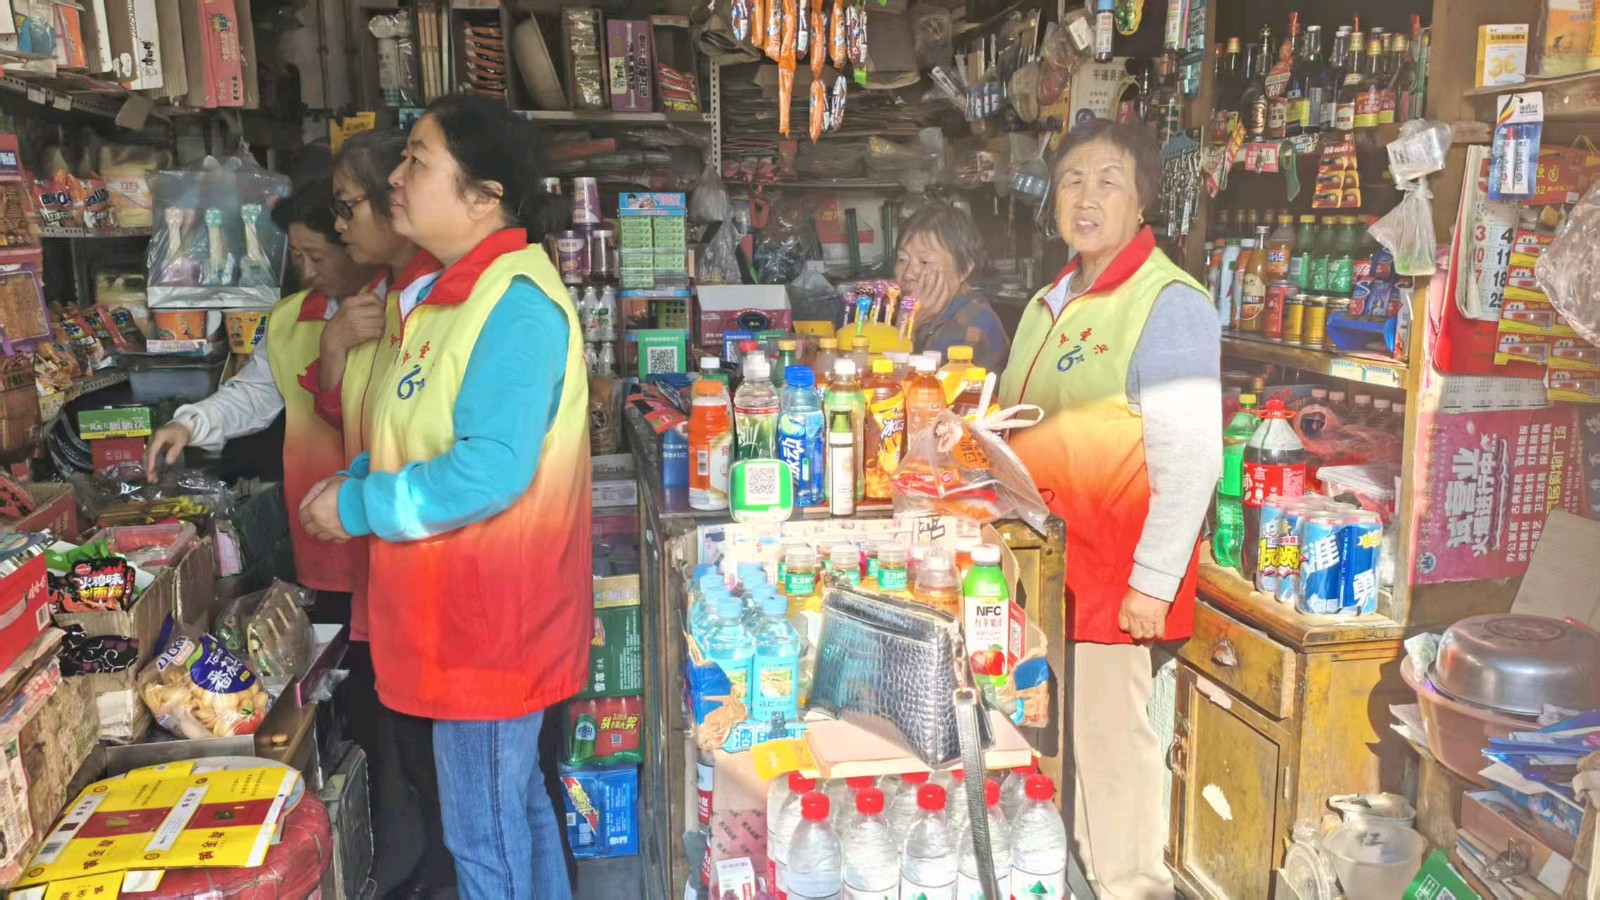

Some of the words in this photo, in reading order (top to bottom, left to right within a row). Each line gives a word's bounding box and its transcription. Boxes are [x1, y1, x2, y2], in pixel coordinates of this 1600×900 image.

[1474, 225, 1486, 242] 3
[1500, 228, 1513, 244] 4
[1445, 447, 1480, 549] 试营业
[79, 572, 124, 591] 火鸡味
[976, 605, 1002, 617] NFC
